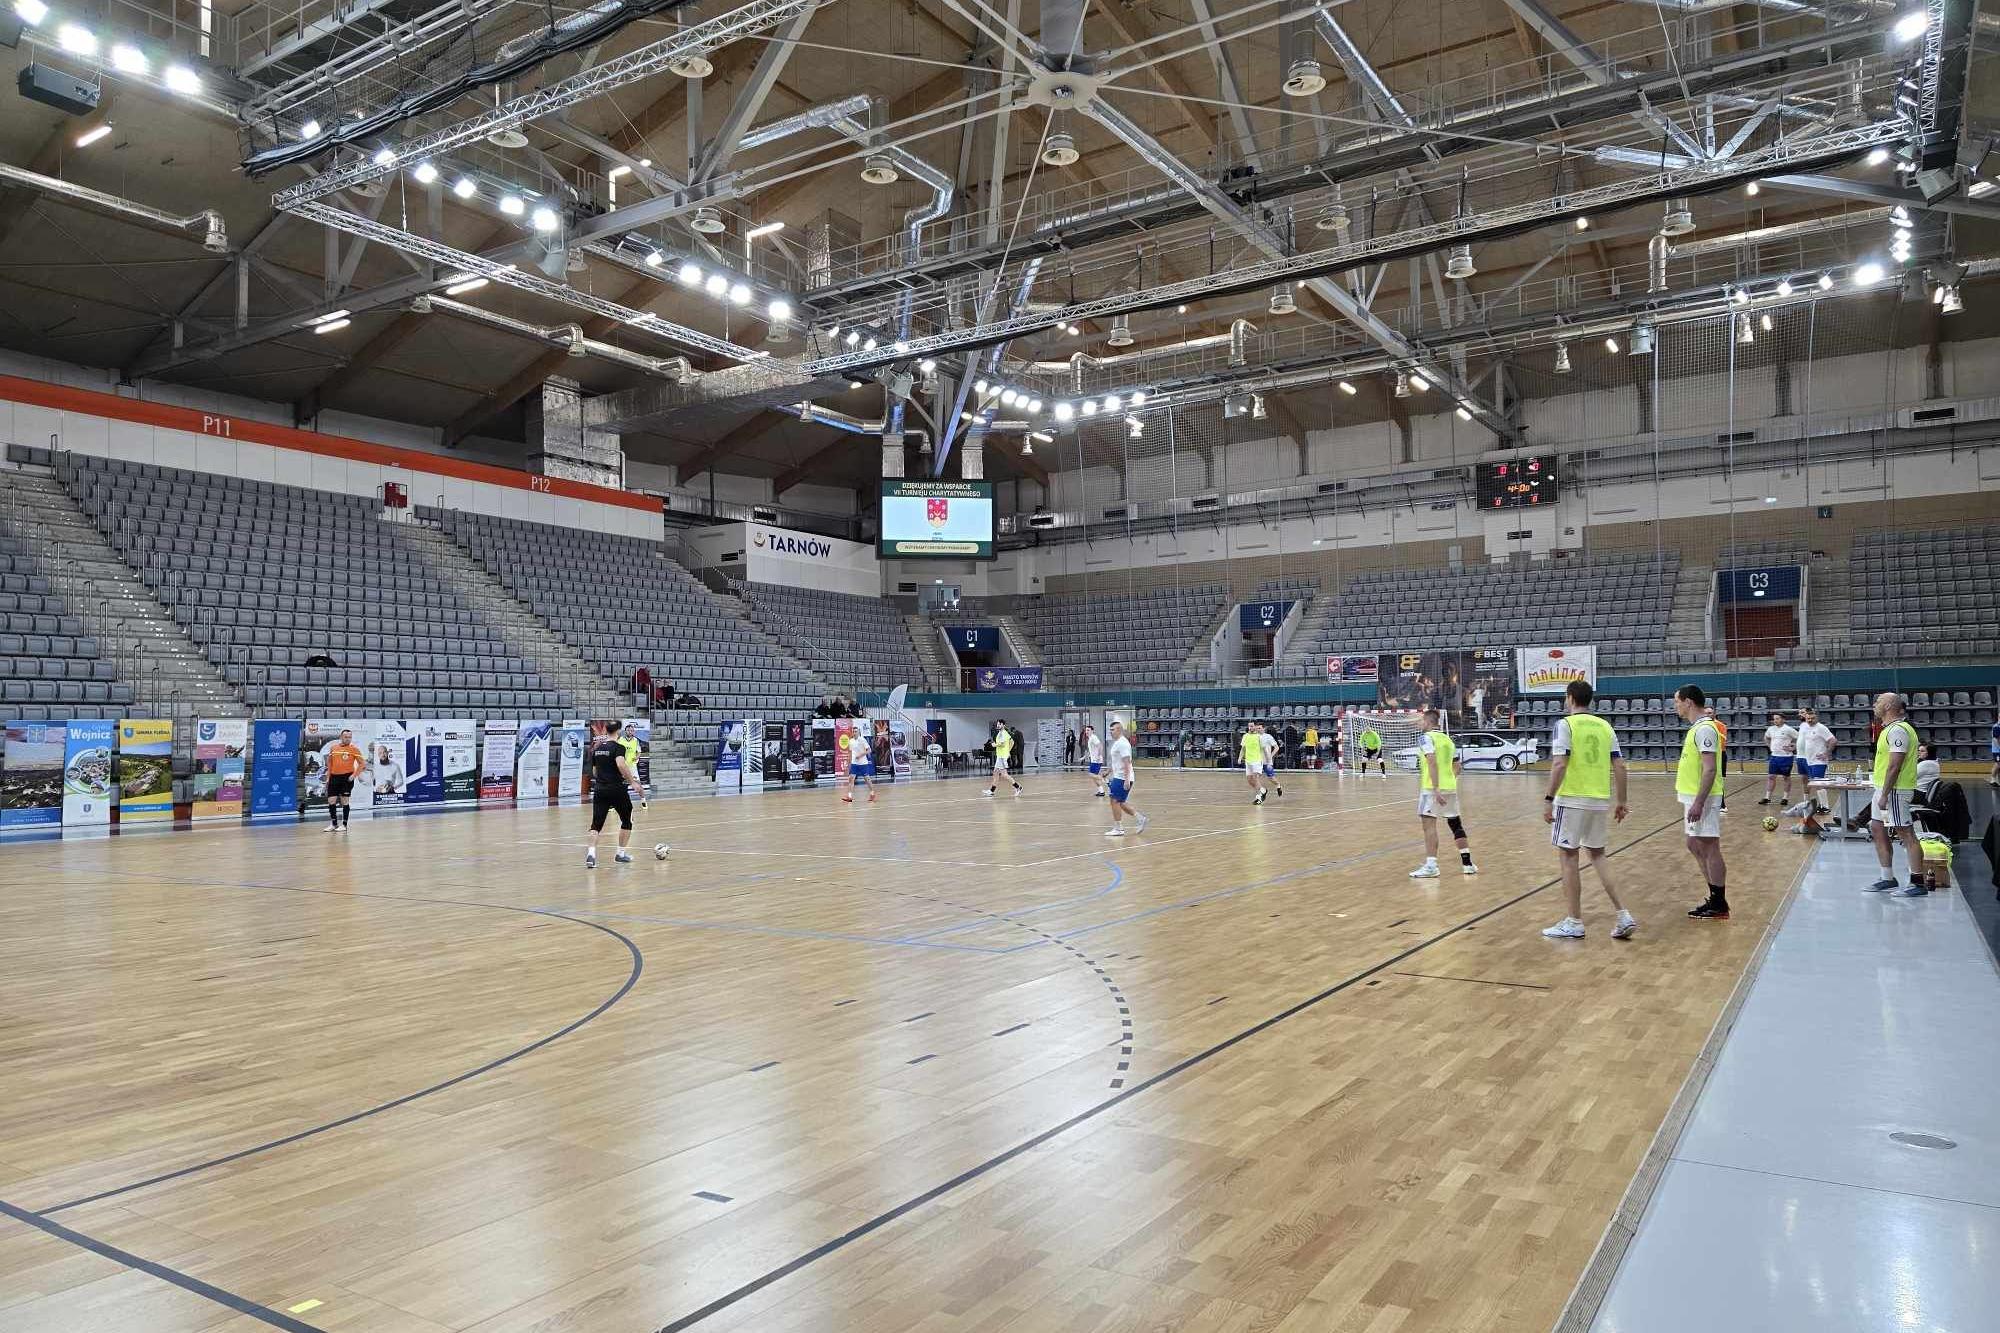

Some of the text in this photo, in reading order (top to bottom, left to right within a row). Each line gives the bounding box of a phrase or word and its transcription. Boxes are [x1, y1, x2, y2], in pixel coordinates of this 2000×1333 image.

[203, 415, 230, 436] P11
[531, 476, 550, 492] P12
[902, 482, 935, 490] DZIĘKUJEMY
[943, 483, 971, 491] WSPARCIE
[902, 489, 928, 497] TURNIEJU
[769, 534, 831, 558] TARNÓW
[1749, 572, 1769, 589] C3
[1261, 605, 1275, 619] C2
[966, 630, 978, 642] C1
[1484, 650, 1508, 658] BEST
[70, 728, 111, 742] Wojnicz
[1583, 733, 1600, 764] 3
